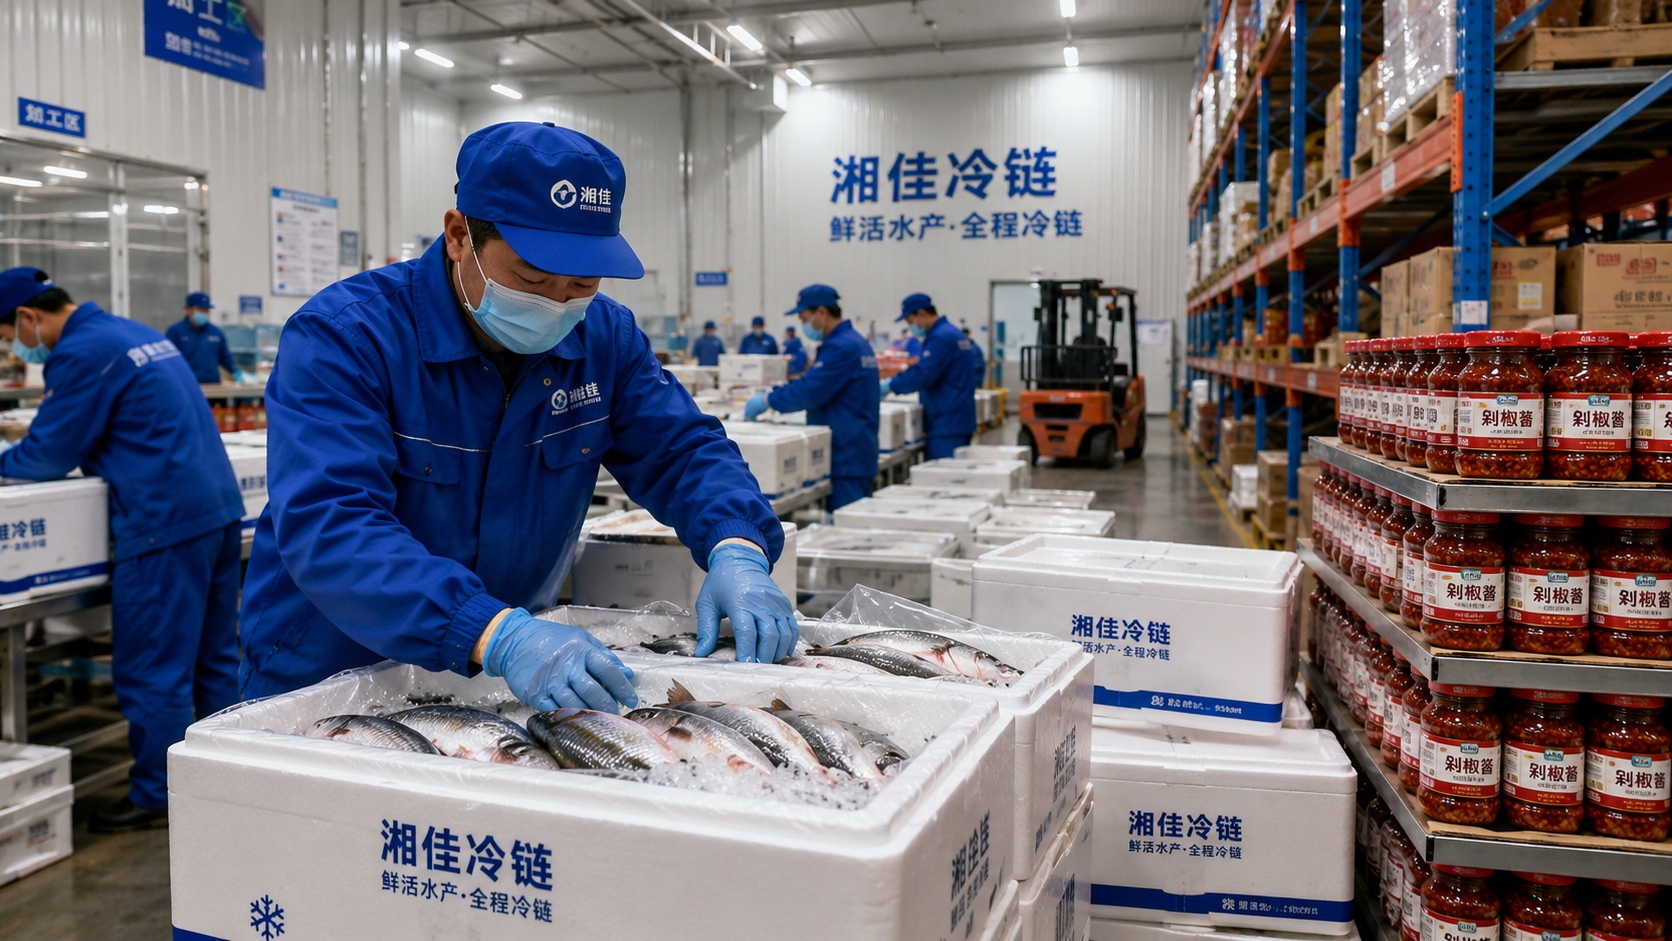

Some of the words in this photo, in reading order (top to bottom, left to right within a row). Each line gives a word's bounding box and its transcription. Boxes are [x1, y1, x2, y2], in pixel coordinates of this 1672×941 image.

[830, 146, 1057, 204] 湘佳冷链
[580, 186, 612, 205] 湘佳
[830, 209, 1083, 242] 鲜活水产·全程冷链
[1071, 614, 1171, 646] 湘佳冷链
[1128, 810, 1243, 842] 湘佳冷链
[381, 818, 554, 892] 湘佳冷链
[1128, 840, 1243, 860] 鲜活水产·全程冷链
[381, 869, 554, 924] 鲜活水产·全程冷链
